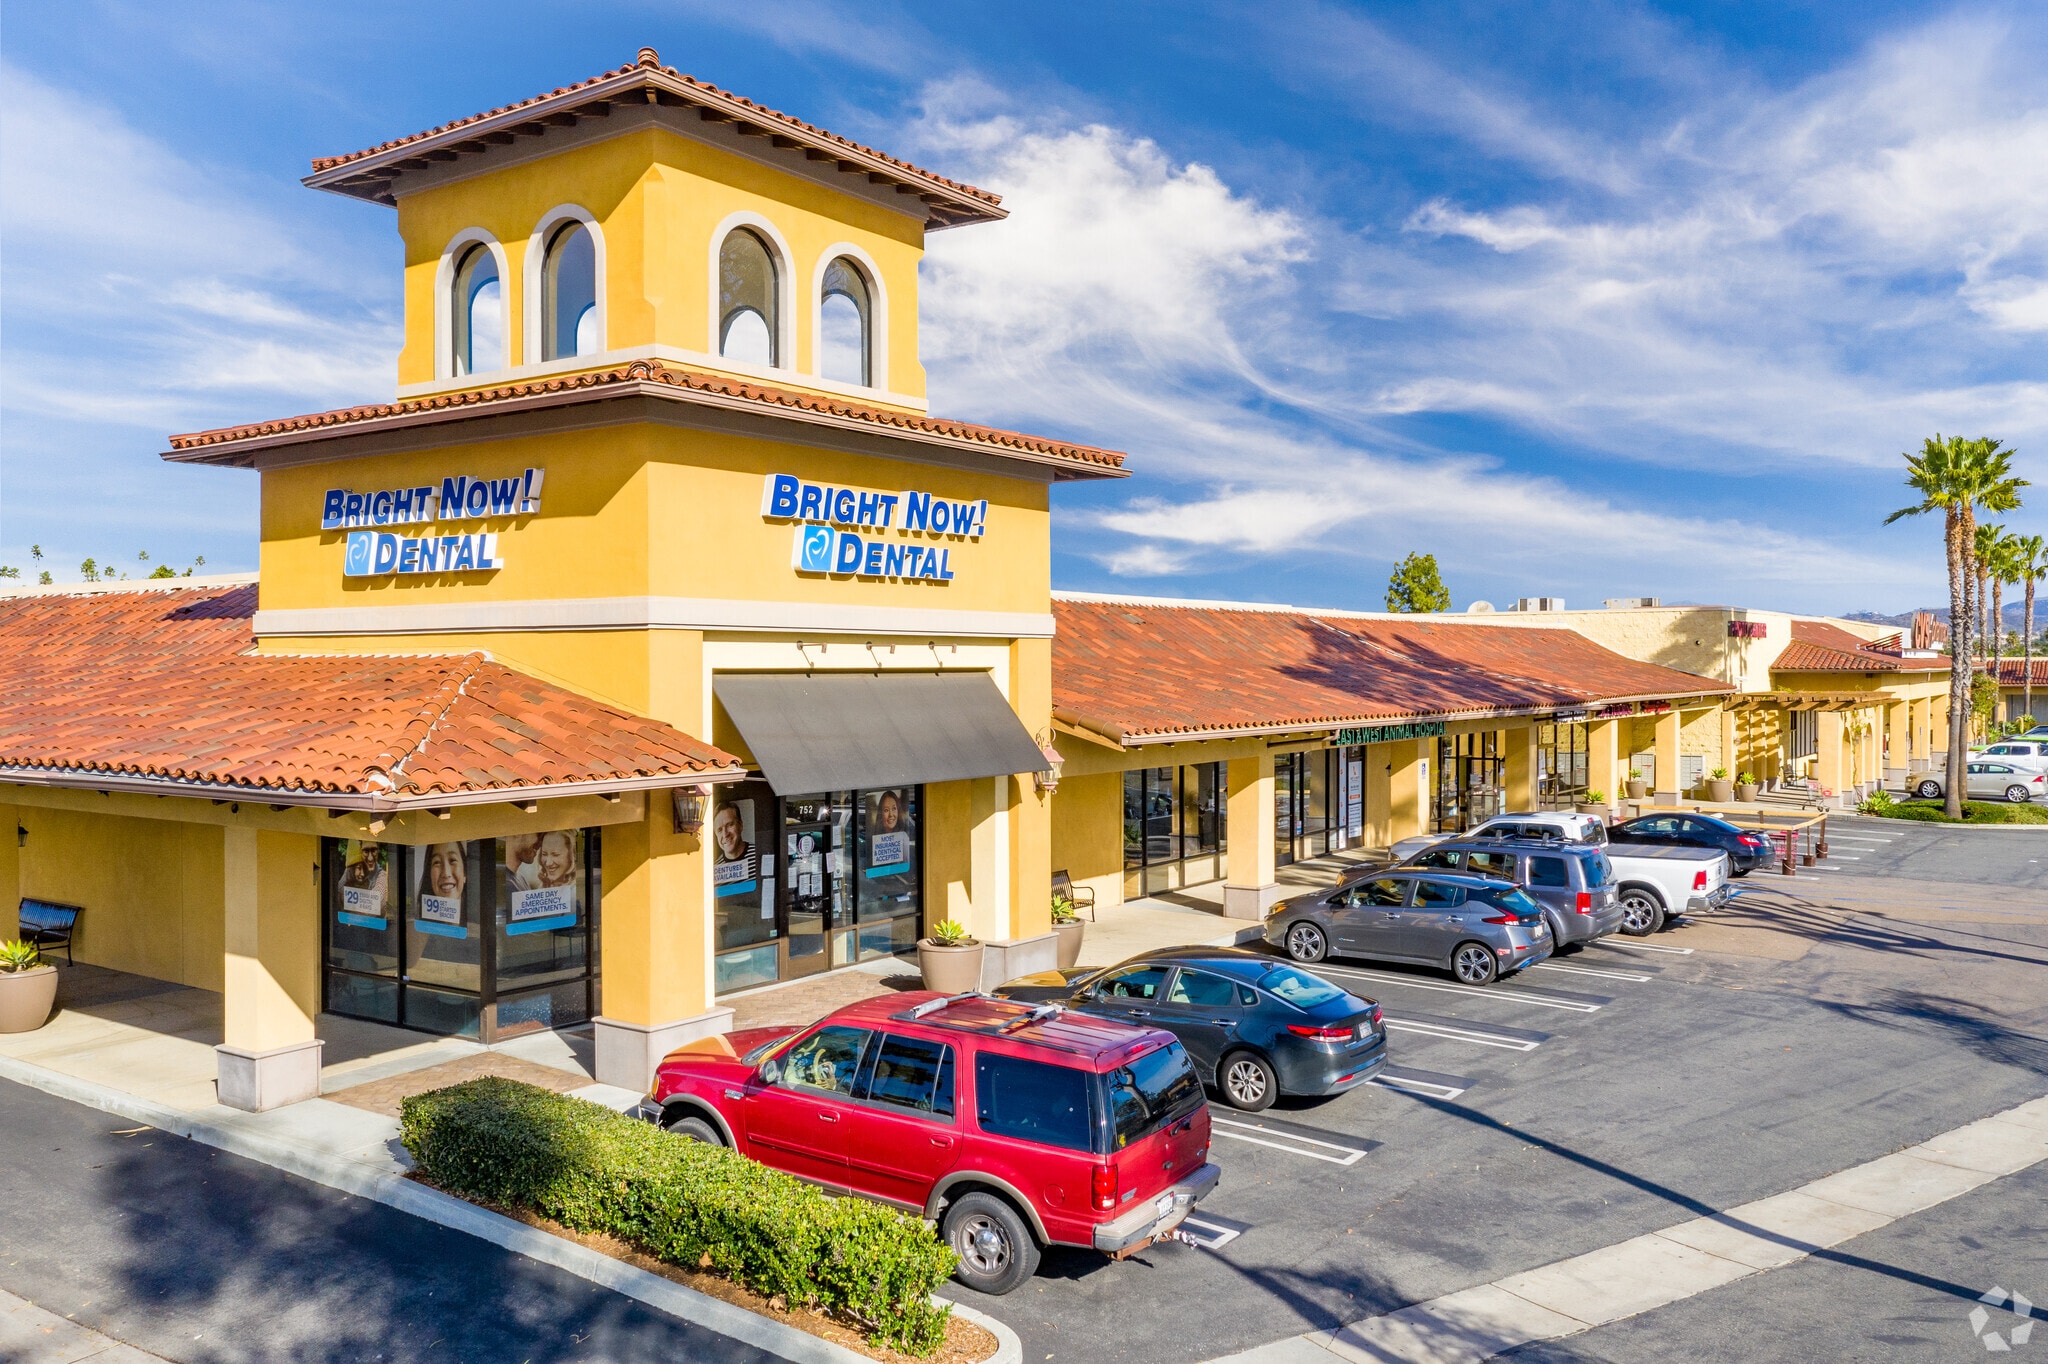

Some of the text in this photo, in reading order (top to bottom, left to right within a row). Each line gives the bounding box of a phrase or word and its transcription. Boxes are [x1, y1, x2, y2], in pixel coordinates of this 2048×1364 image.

[321, 468, 536, 529] BRIGHT NOW!
[770, 474, 988, 536] BRIGHT NOW!
[374, 533, 494, 574] DENTAL
[836, 533, 954, 580] DENTAL
[1362, 726, 1383, 743] WEST
[1384, 724, 1413, 741] ANIMAL
[1415, 721, 1446, 738] HOSPITAL
[799, 805, 813, 814] 752
[521, 897, 562, 908] EMERGENCY
[525, 892, 543, 900] SAME
